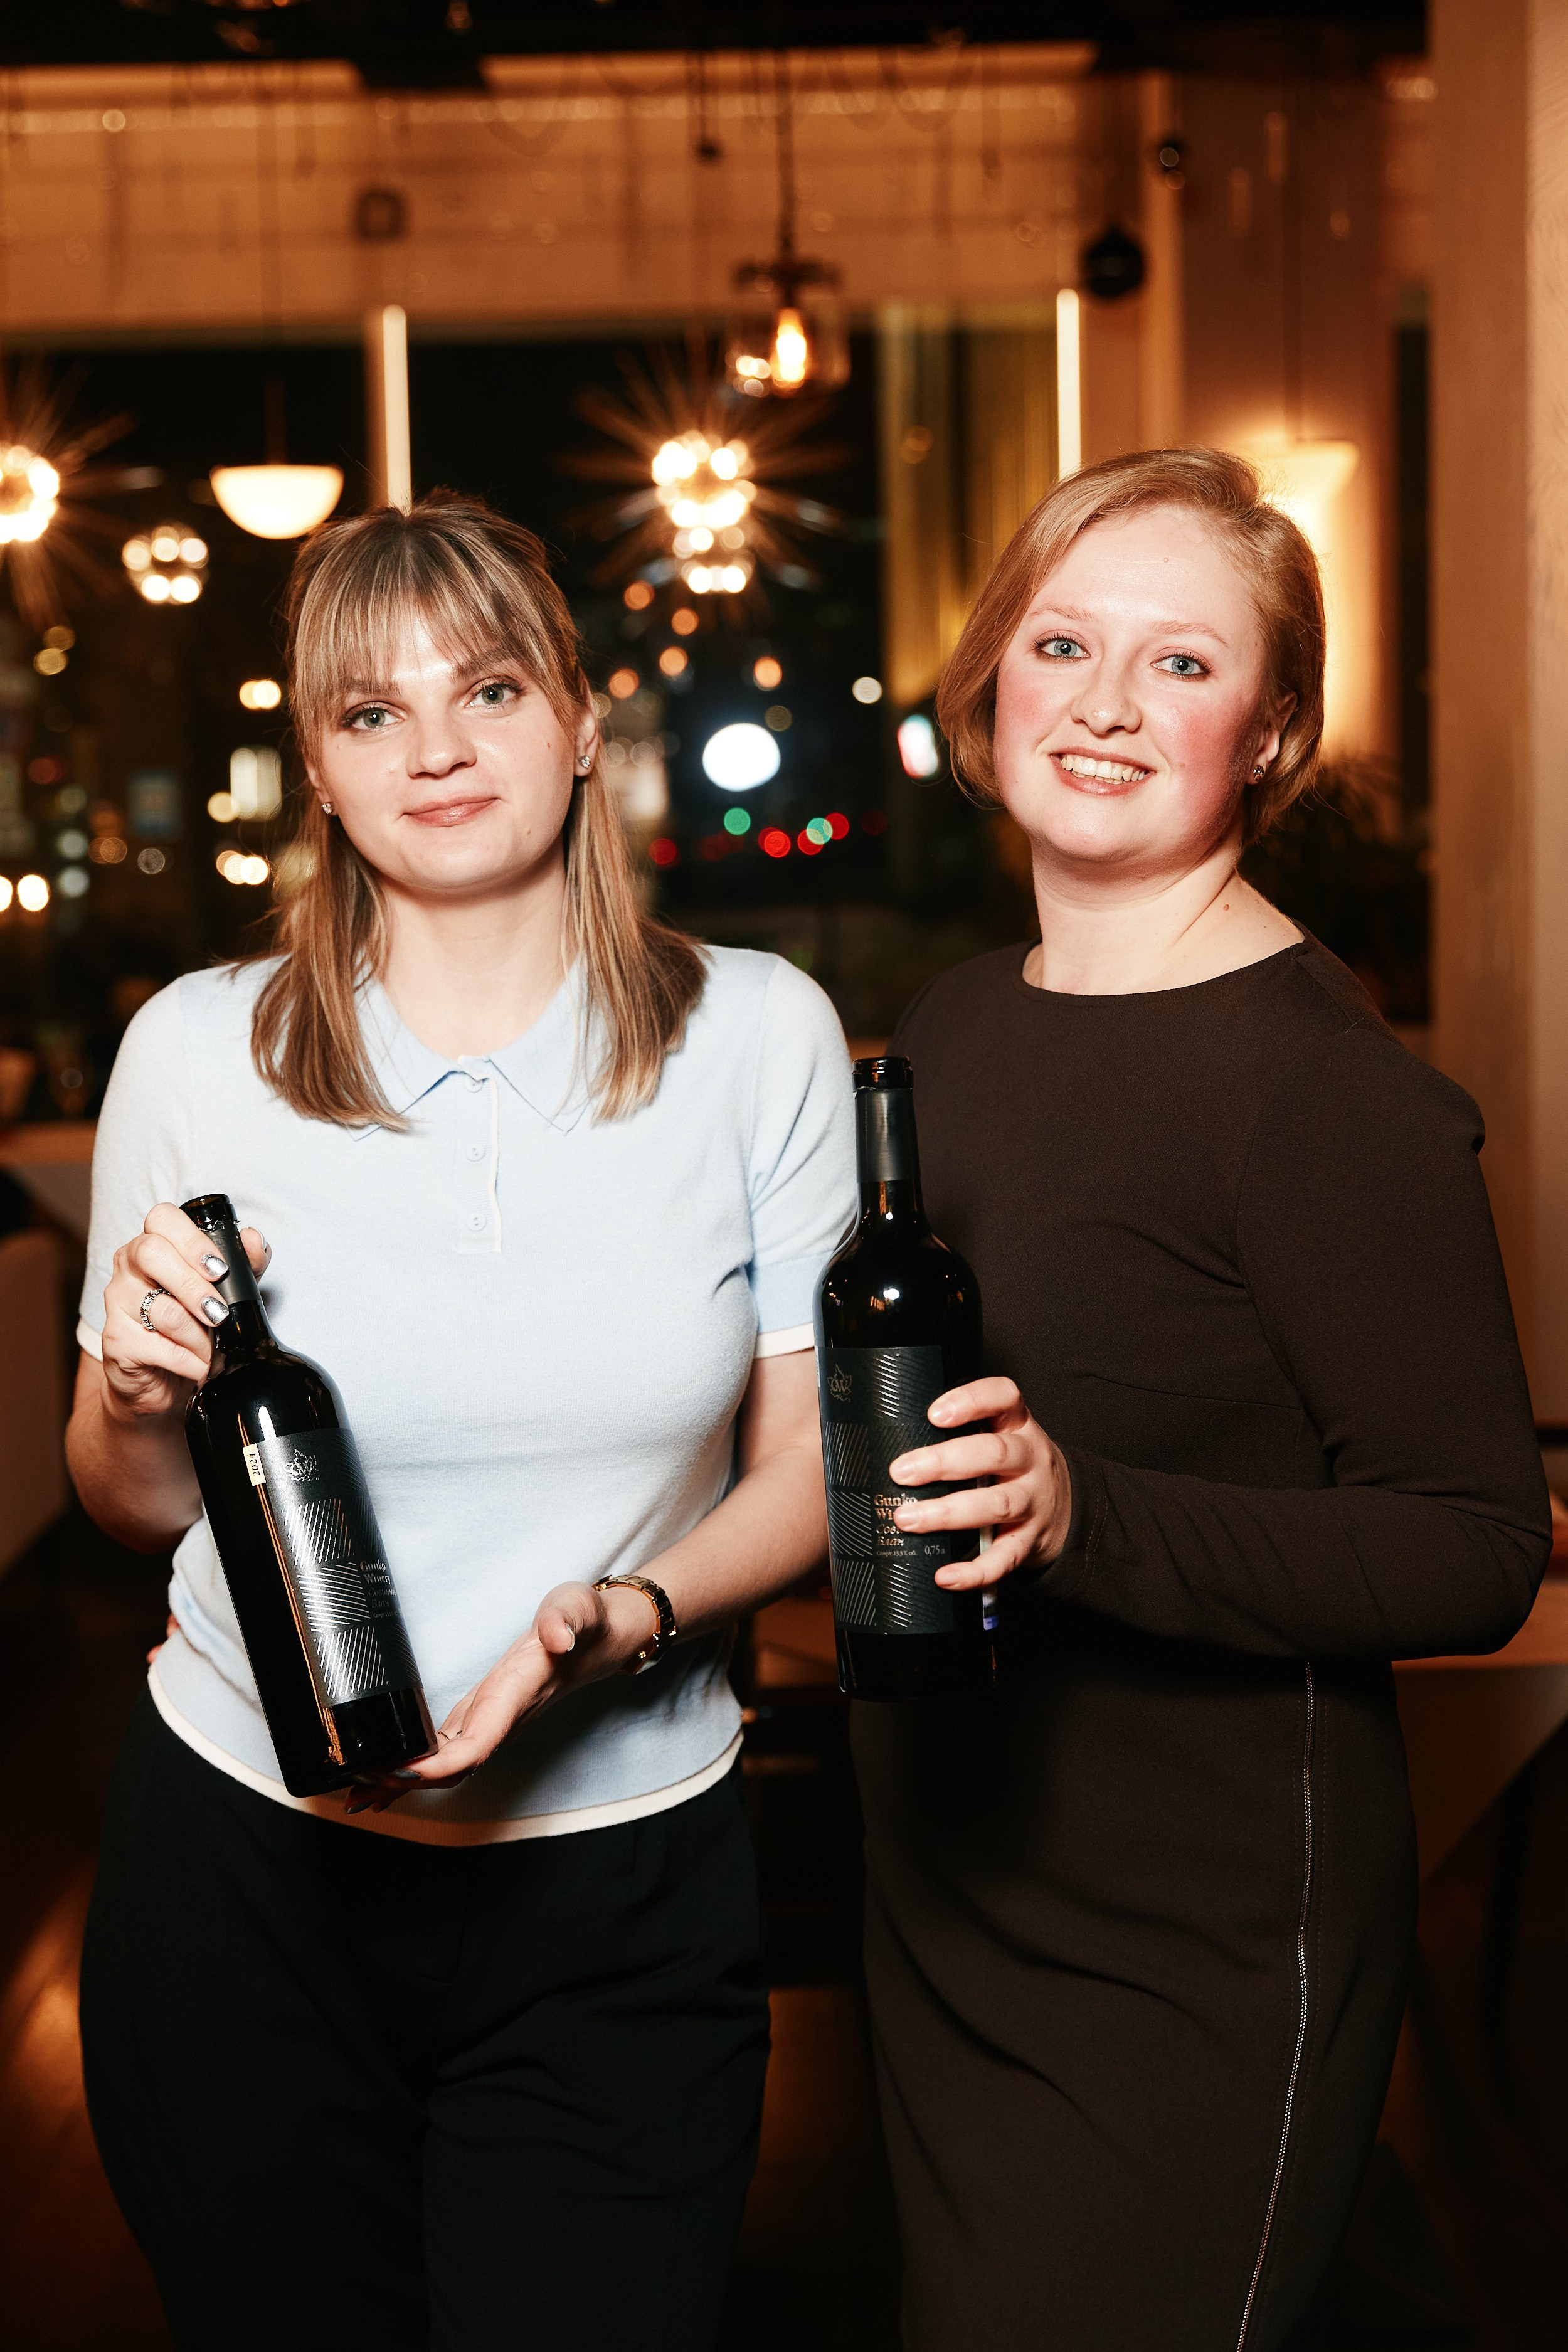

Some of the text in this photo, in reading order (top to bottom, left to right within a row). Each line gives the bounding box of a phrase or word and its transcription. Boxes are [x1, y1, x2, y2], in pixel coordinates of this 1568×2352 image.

[247, 1453, 260, 1476] 2024
[874, 1493, 918, 1507] Gunko
[876, 1535, 904, 1547] Блан
[360, 1559, 386, 1572] Gunko
[363, 1573, 391, 1585] Winery
